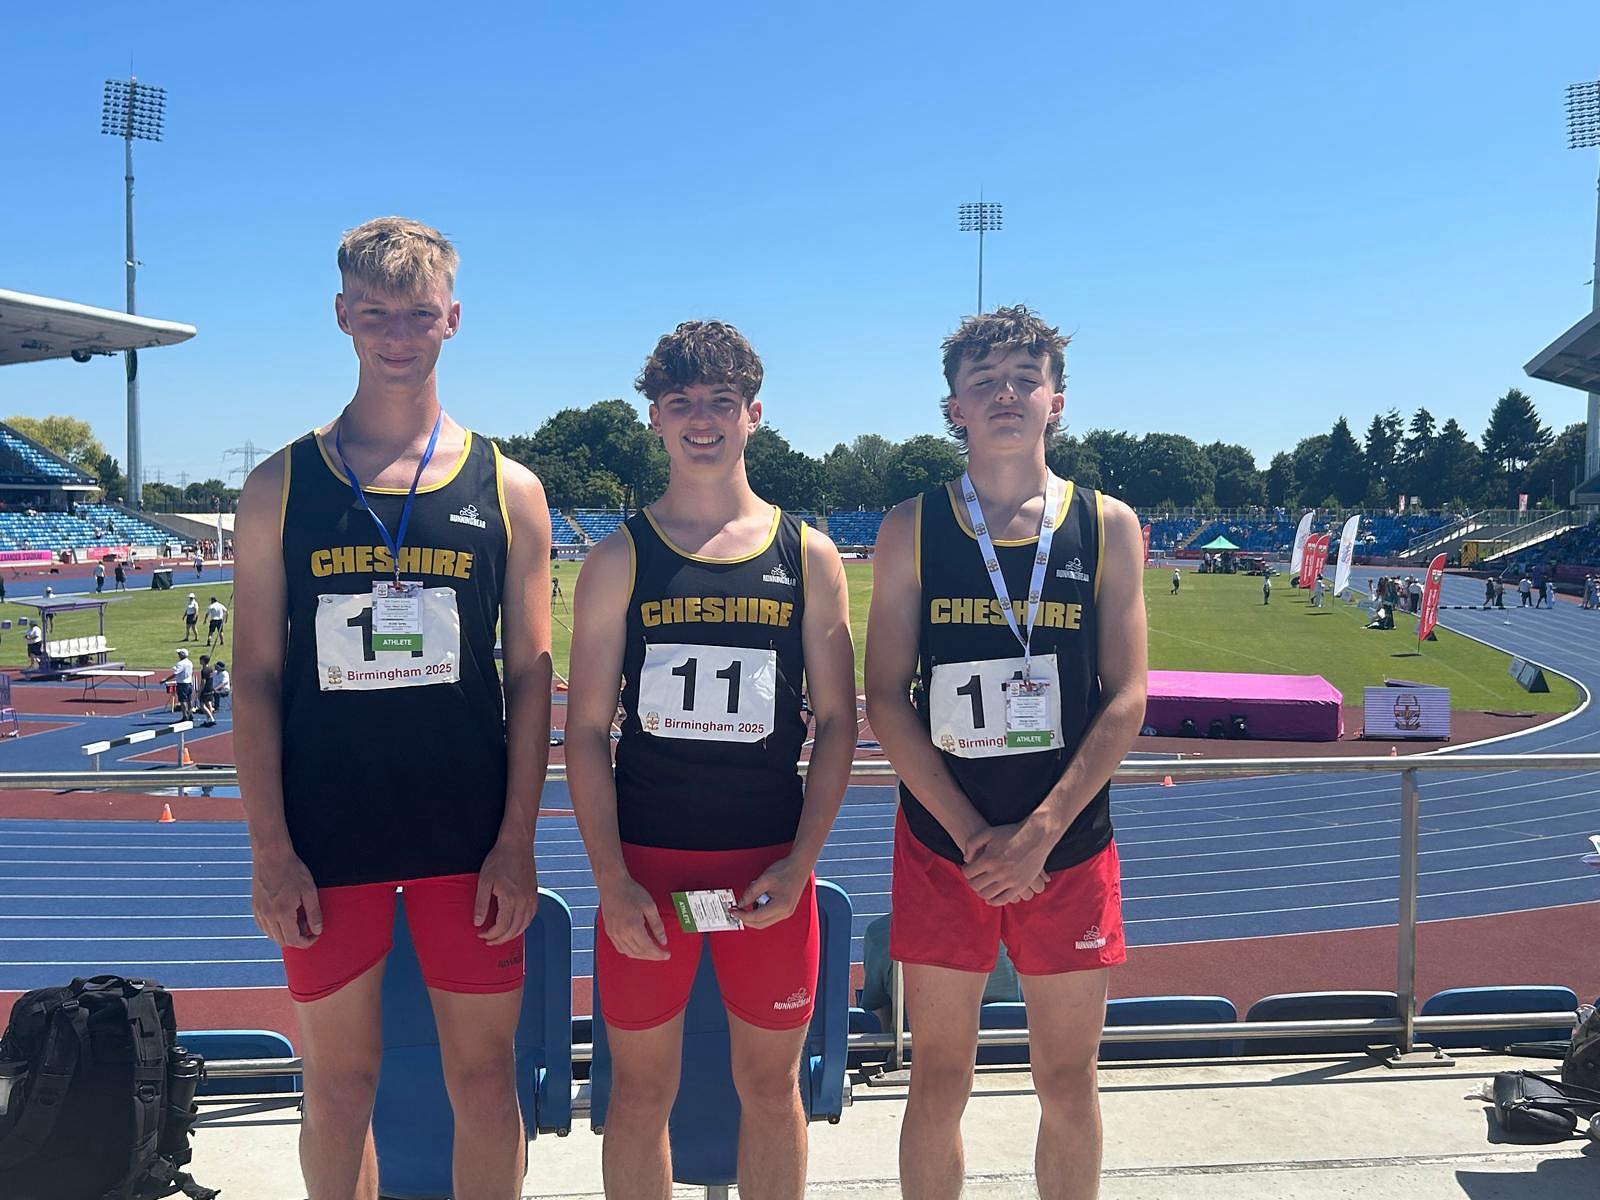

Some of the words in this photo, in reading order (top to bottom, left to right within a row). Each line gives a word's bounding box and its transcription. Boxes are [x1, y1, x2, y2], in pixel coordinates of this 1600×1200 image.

[310, 545, 475, 580] CHESHIRE
[640, 597, 794, 628] CHESHIRE
[382, 638, 413, 647] ATHLETE
[347, 666, 422, 681] Birmingham
[425, 663, 452, 676] 2025
[671, 657, 742, 714] 11
[664, 717, 734, 733] Birmingham
[738, 722, 765, 734] 2025
[958, 735, 1007, 749] Birming
[1015, 735, 1042, 743] ATHLETE
